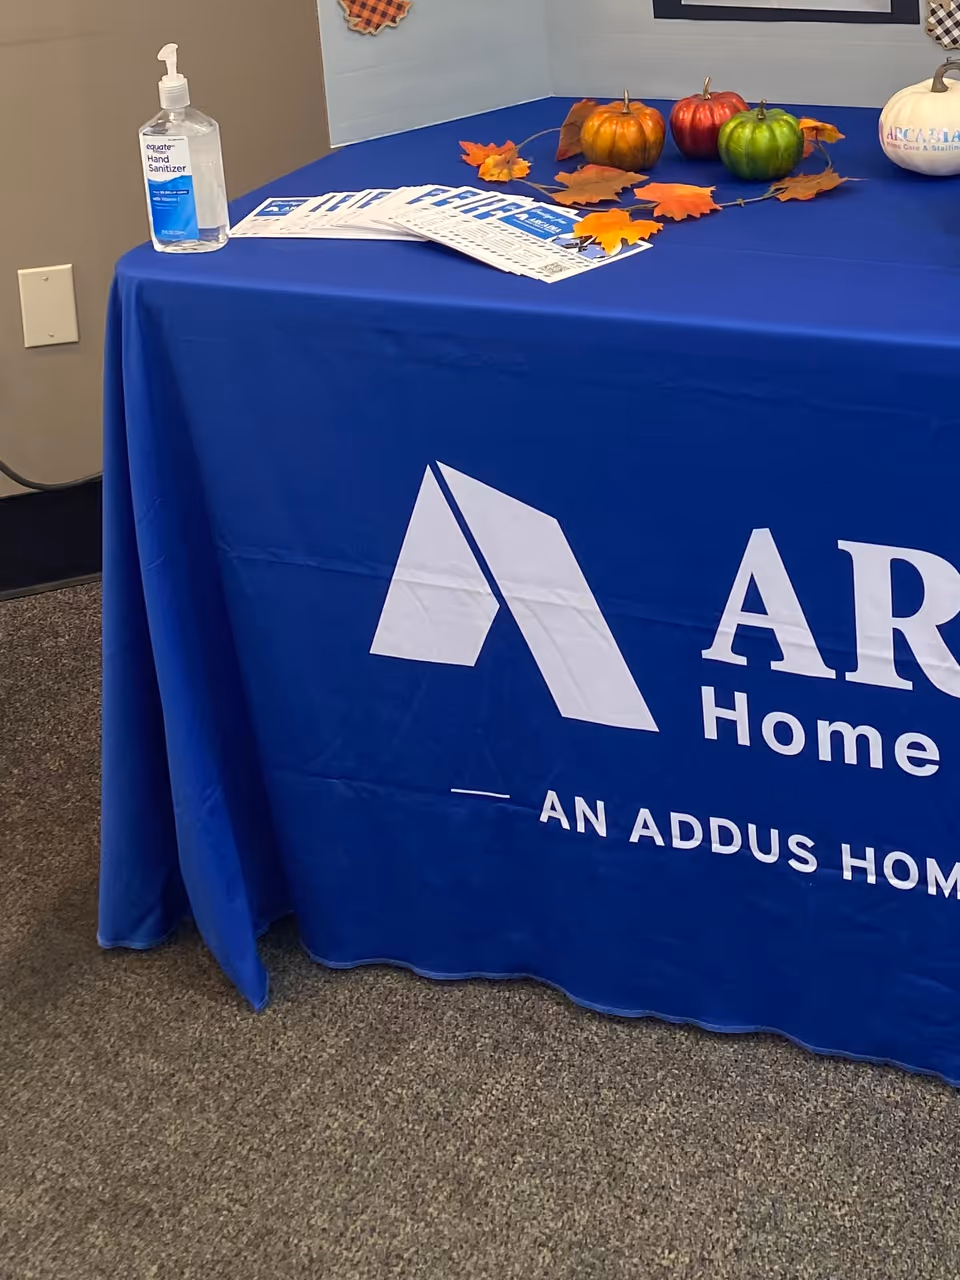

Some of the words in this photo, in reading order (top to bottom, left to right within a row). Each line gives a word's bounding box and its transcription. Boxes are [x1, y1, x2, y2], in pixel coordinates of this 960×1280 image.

[146, 144, 172, 152] equate
[147, 155, 169, 163] Hand
[149, 164, 186, 172] Sanitizer
[701, 685, 941, 778] Home
[538, 789, 608, 838] AN
[628, 807, 819, 874] ADDUS
